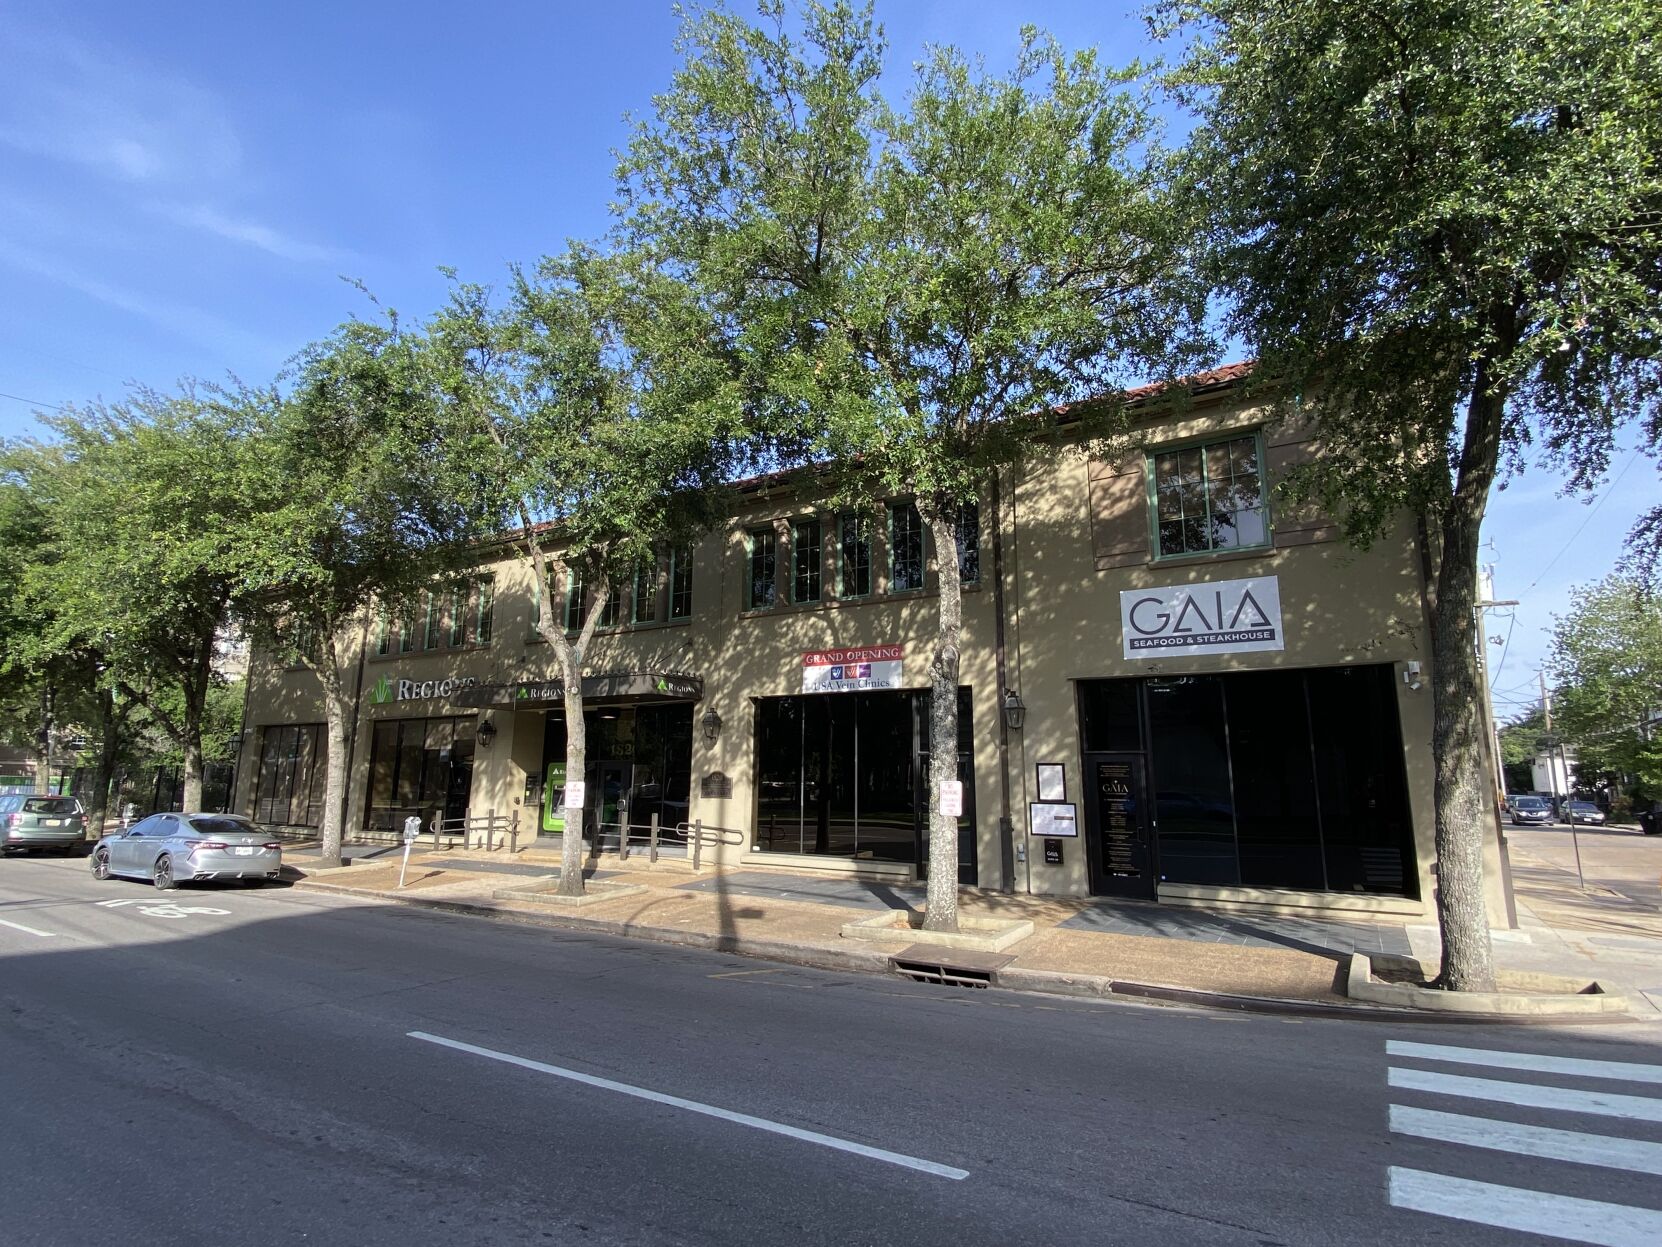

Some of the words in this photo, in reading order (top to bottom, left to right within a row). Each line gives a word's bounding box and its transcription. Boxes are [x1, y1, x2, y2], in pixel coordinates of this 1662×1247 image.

[1129, 588, 1272, 635] GAIA
[1133, 637, 1184, 648] SEAFOOD
[1196, 631, 1271, 644] STEAKHOUSE
[806, 652, 844, 664] GRAND
[846, 647, 899, 660] OPENING
[814, 681, 833, 691] USA
[836, 680, 855, 690] Vein
[858, 678, 890, 689] Clinics
[1102, 783, 1129, 793] GAIA
